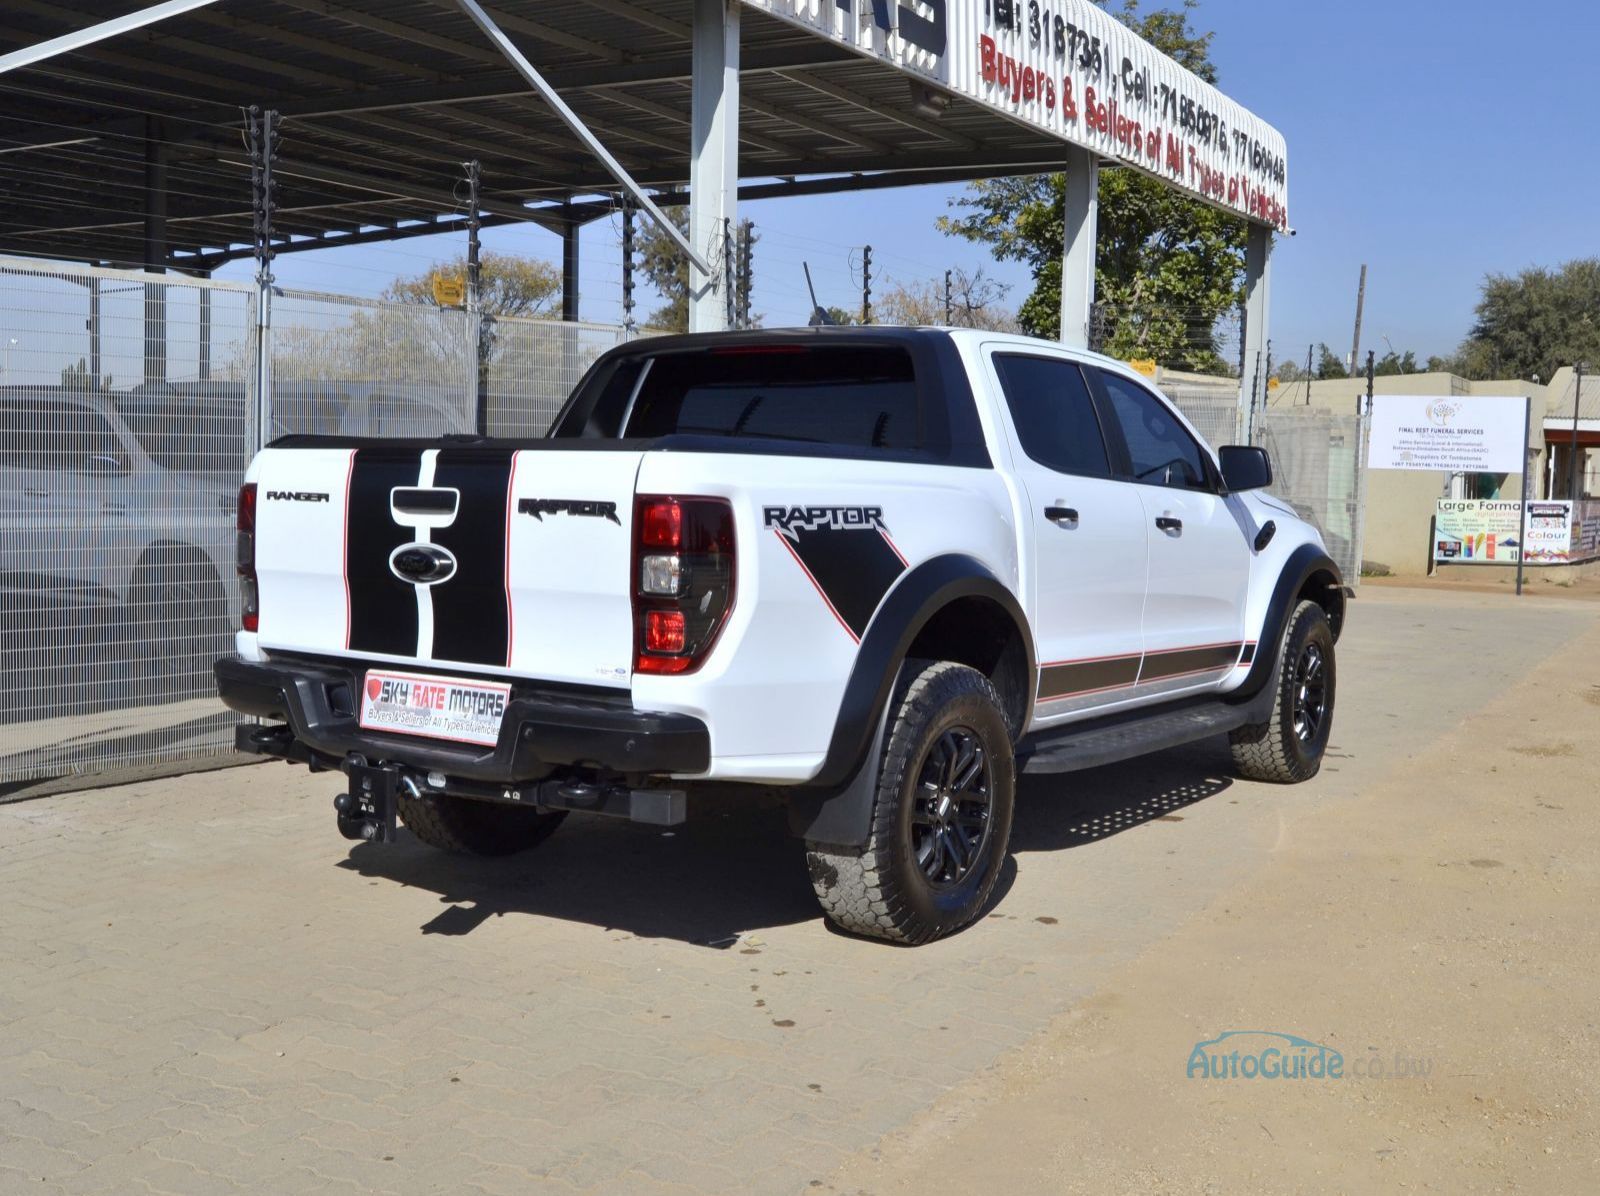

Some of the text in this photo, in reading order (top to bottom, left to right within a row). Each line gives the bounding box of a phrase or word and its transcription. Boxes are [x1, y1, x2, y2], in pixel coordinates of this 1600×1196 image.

[981, 33, 1056, 109] Buyers
[1062, 75, 1078, 119] &
[1084, 86, 1142, 153] Sellers
[1147, 126, 1161, 163] of
[1166, 133, 1184, 175] All
[266, 491, 330, 502] RANGER
[1438, 501, 1521, 512] Large Forma
[518, 498, 621, 527] RAPTOR
[762, 505, 893, 543] RAPTOR
[1527, 531, 1567, 539] Colour
[381, 680, 505, 718] SKY GATE MOTORS
[368, 708, 392, 722] Buyers
[400, 712, 423, 726] Sellers
[424, 715, 432, 726] of
[432, 716, 442, 727] All
[444, 717, 464, 732] Types
